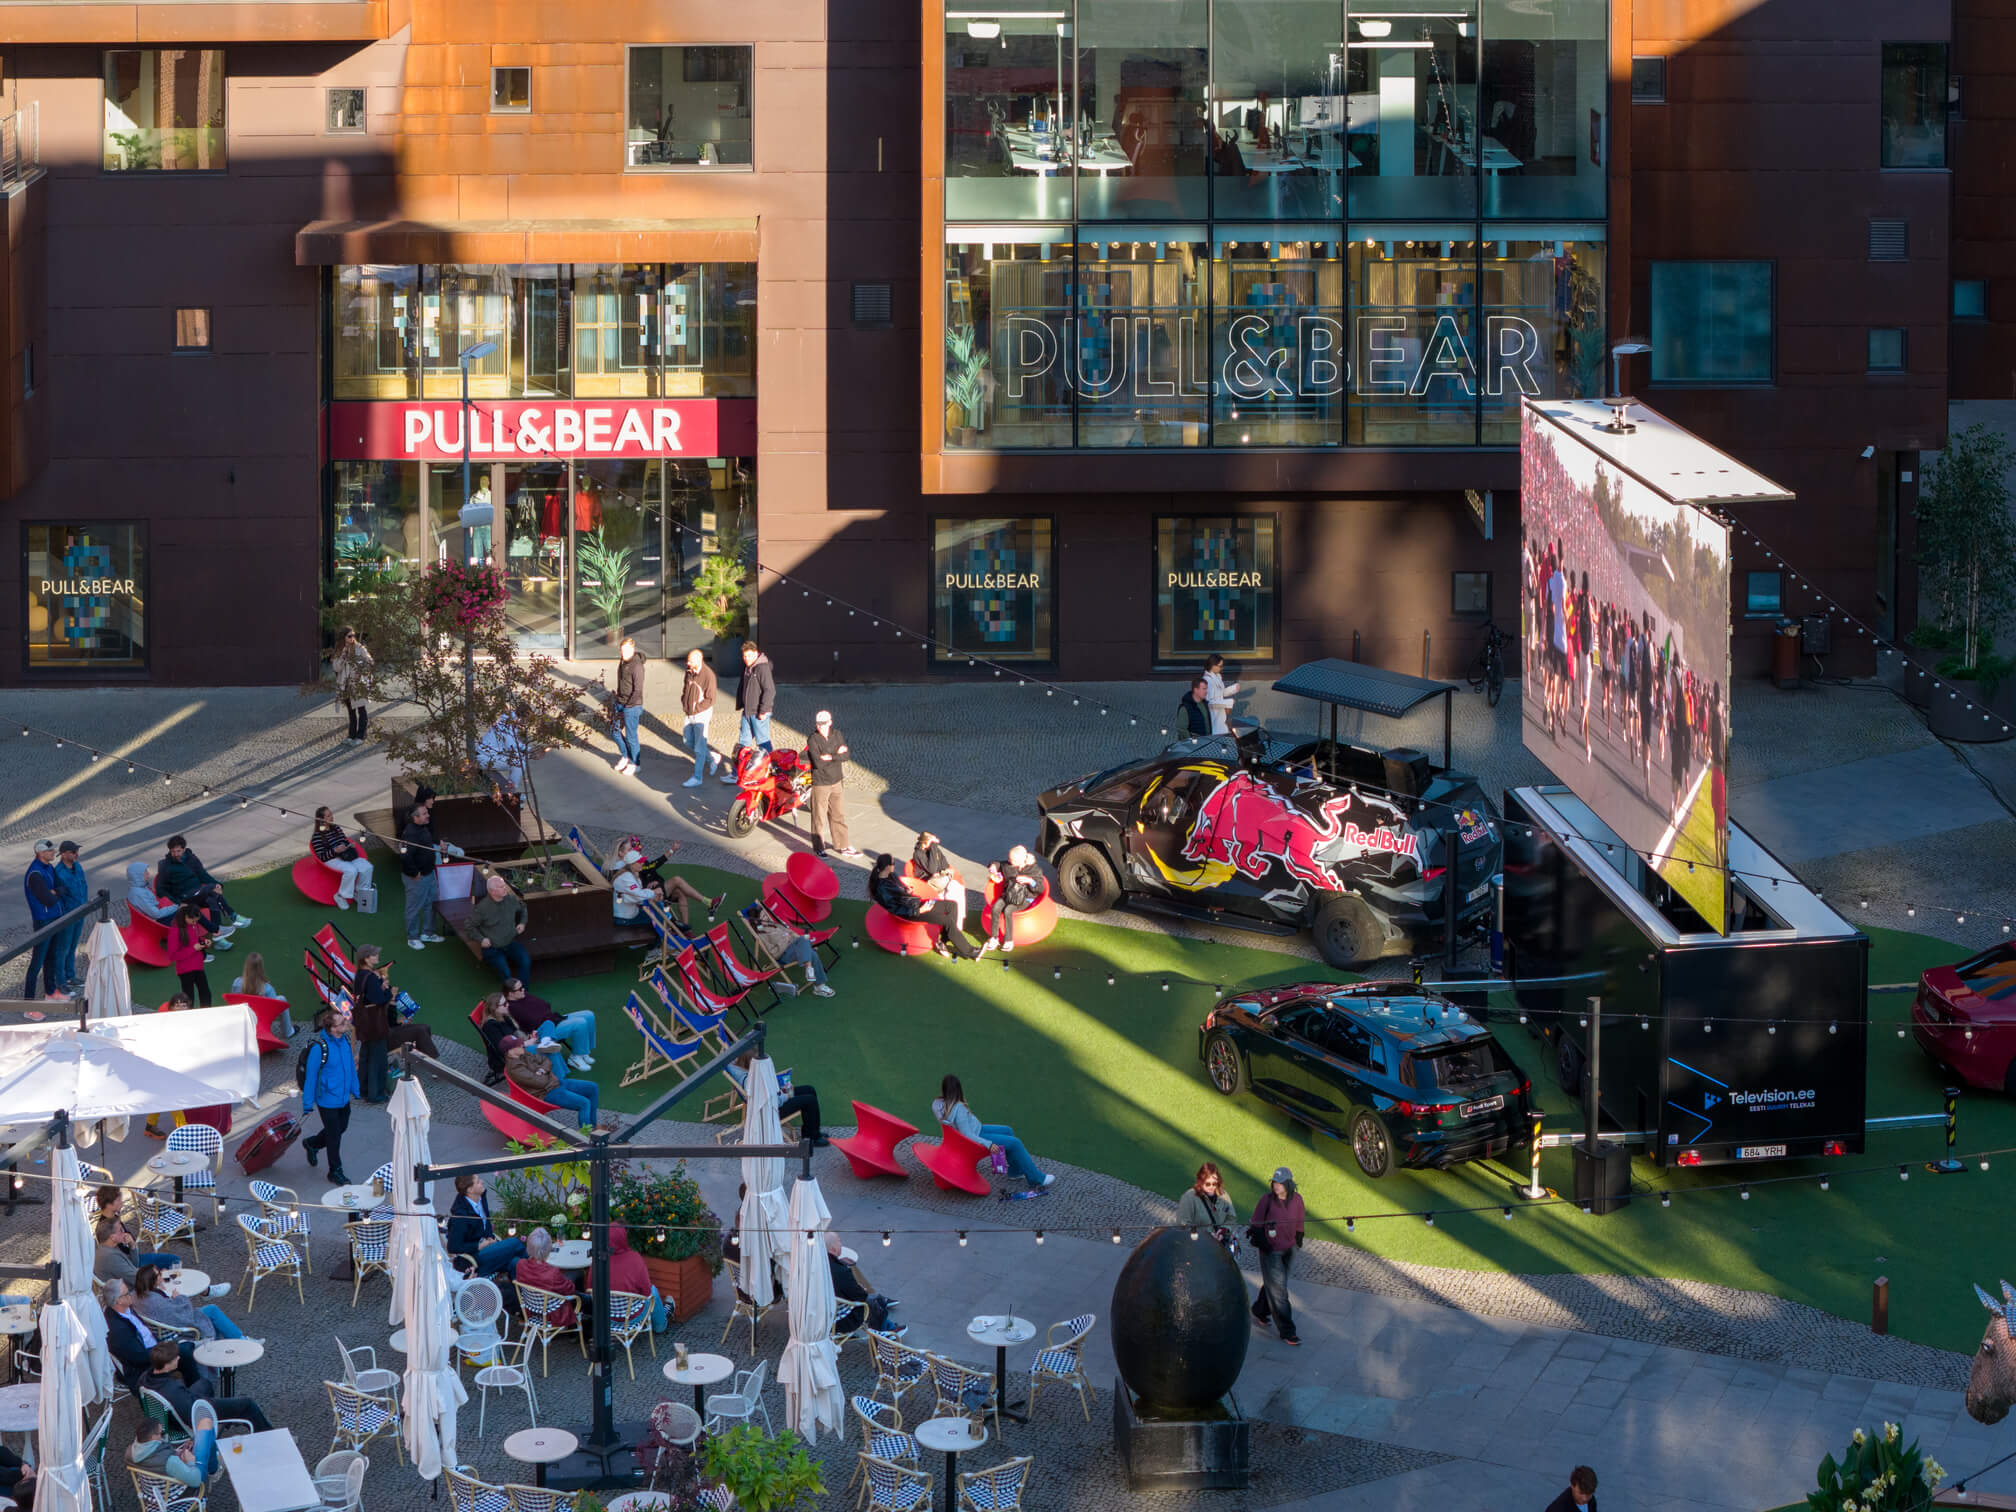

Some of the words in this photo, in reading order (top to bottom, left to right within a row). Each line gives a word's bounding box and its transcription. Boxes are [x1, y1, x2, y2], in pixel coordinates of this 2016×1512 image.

[1006, 315, 1541, 399] PULL&BEAR
[404, 407, 682, 453] PULL&BEAR
[41, 579, 135, 595] PULL&BEAR
[946, 573, 1040, 589] PULL&BEAR
[1168, 572, 1262, 588] PULL&BEAR
[1728, 1088, 1816, 1105] Television.ee
[1789, 1101, 1816, 1109] TELEKAS
[1744, 1147, 1760, 1157] 684
[1764, 1146, 1783, 1155] YRH
